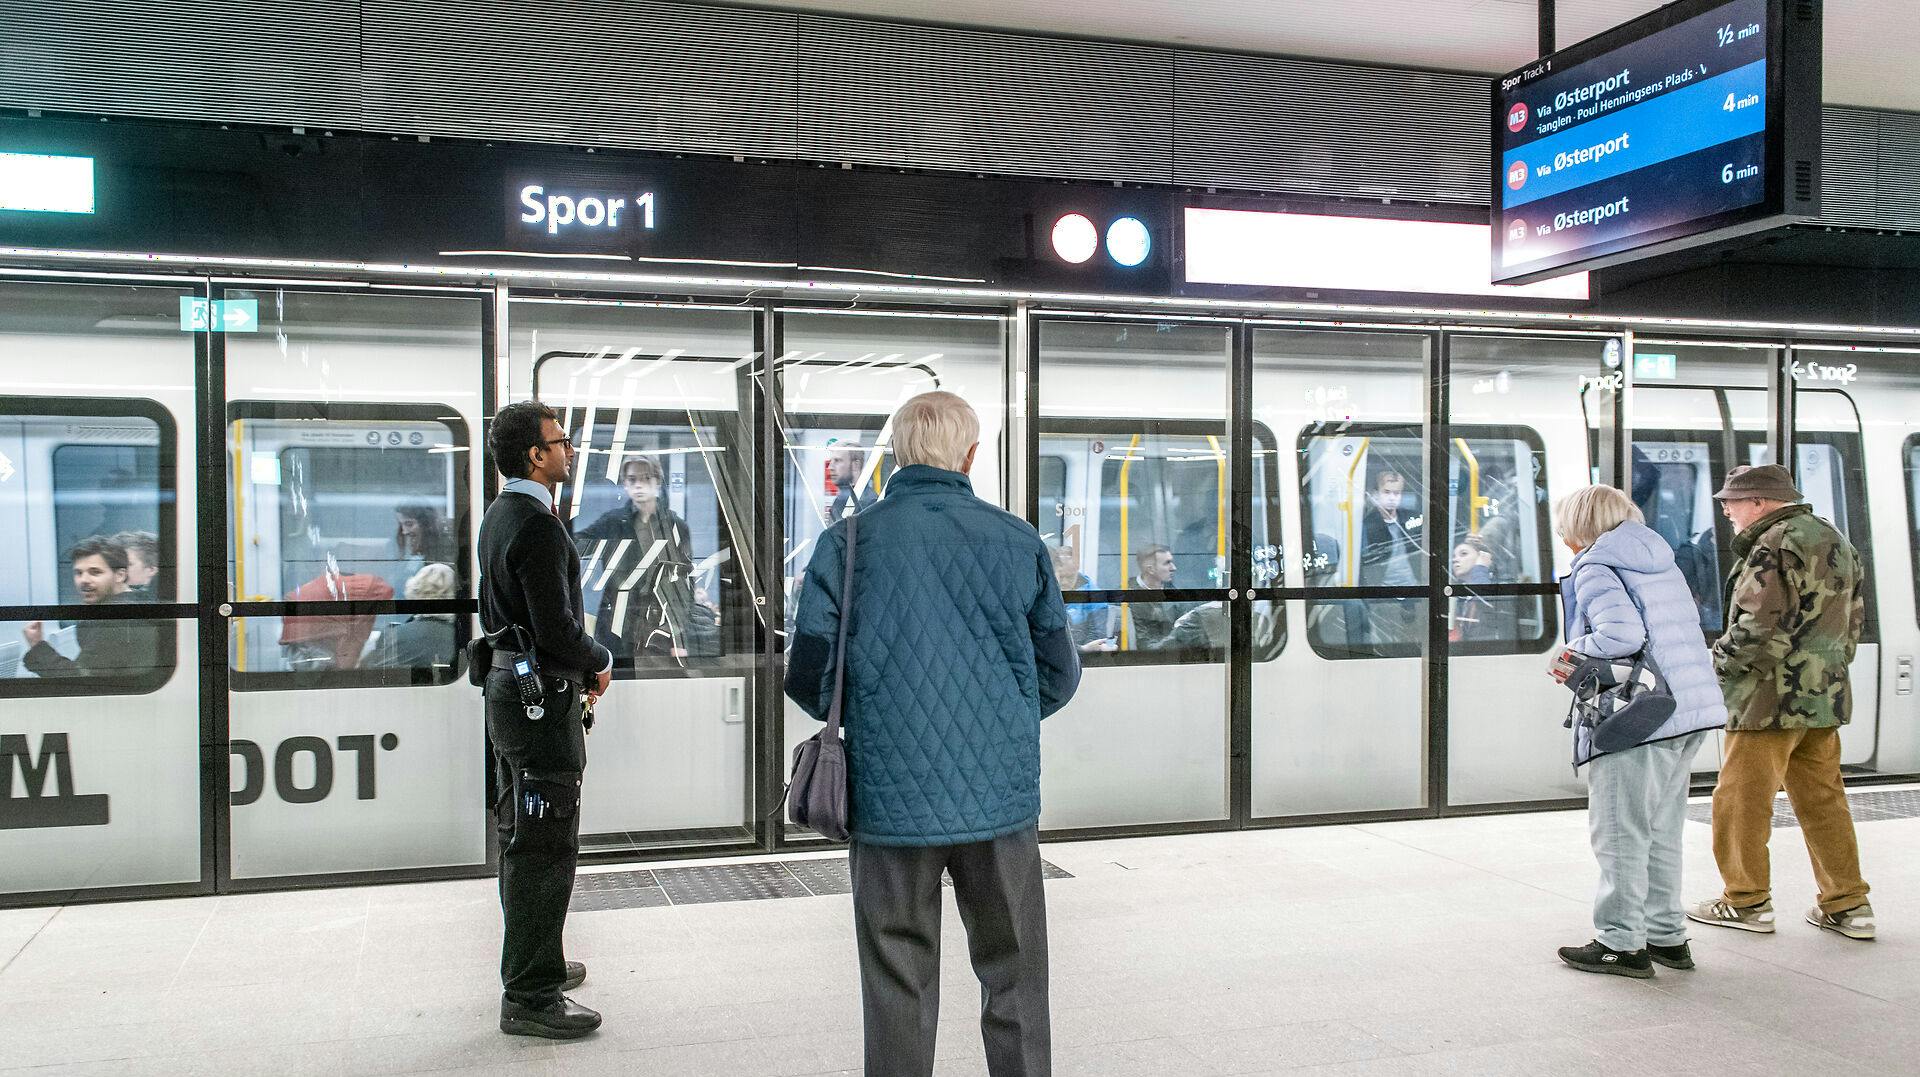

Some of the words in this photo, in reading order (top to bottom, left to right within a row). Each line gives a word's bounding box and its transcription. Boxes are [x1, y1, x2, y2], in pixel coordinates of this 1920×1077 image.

[1737, 23, 1760, 41] min
[1501, 74, 1522, 91] Spor
[1522, 66, 1544, 81] Track
[1546, 60, 1551, 72] 1
[1536, 105, 1552, 119] Via
[1554, 68, 1630, 112] Østerport
[1577, 101, 1598, 121] Poul
[1600, 82, 1663, 112] Henningsens
[1665, 68, 1693, 88] Plads
[1722, 92, 1736, 113] 4
[1736, 93, 1759, 111] min
[1508, 109, 1526, 127] M3
[1536, 164, 1552, 178] Via
[1553, 131, 1630, 172] Østerport
[1508, 168, 1525, 184] M3
[1721, 162, 1734, 184] 6
[1736, 164, 1759, 180] min
[520, 184, 625, 235] Spor
[635, 191, 654, 229] 1
[1536, 224, 1551, 237] Via
[1553, 195, 1630, 232] Østerport
[1508, 226, 1525, 241] M3
[1062, 523, 1081, 570] 1
